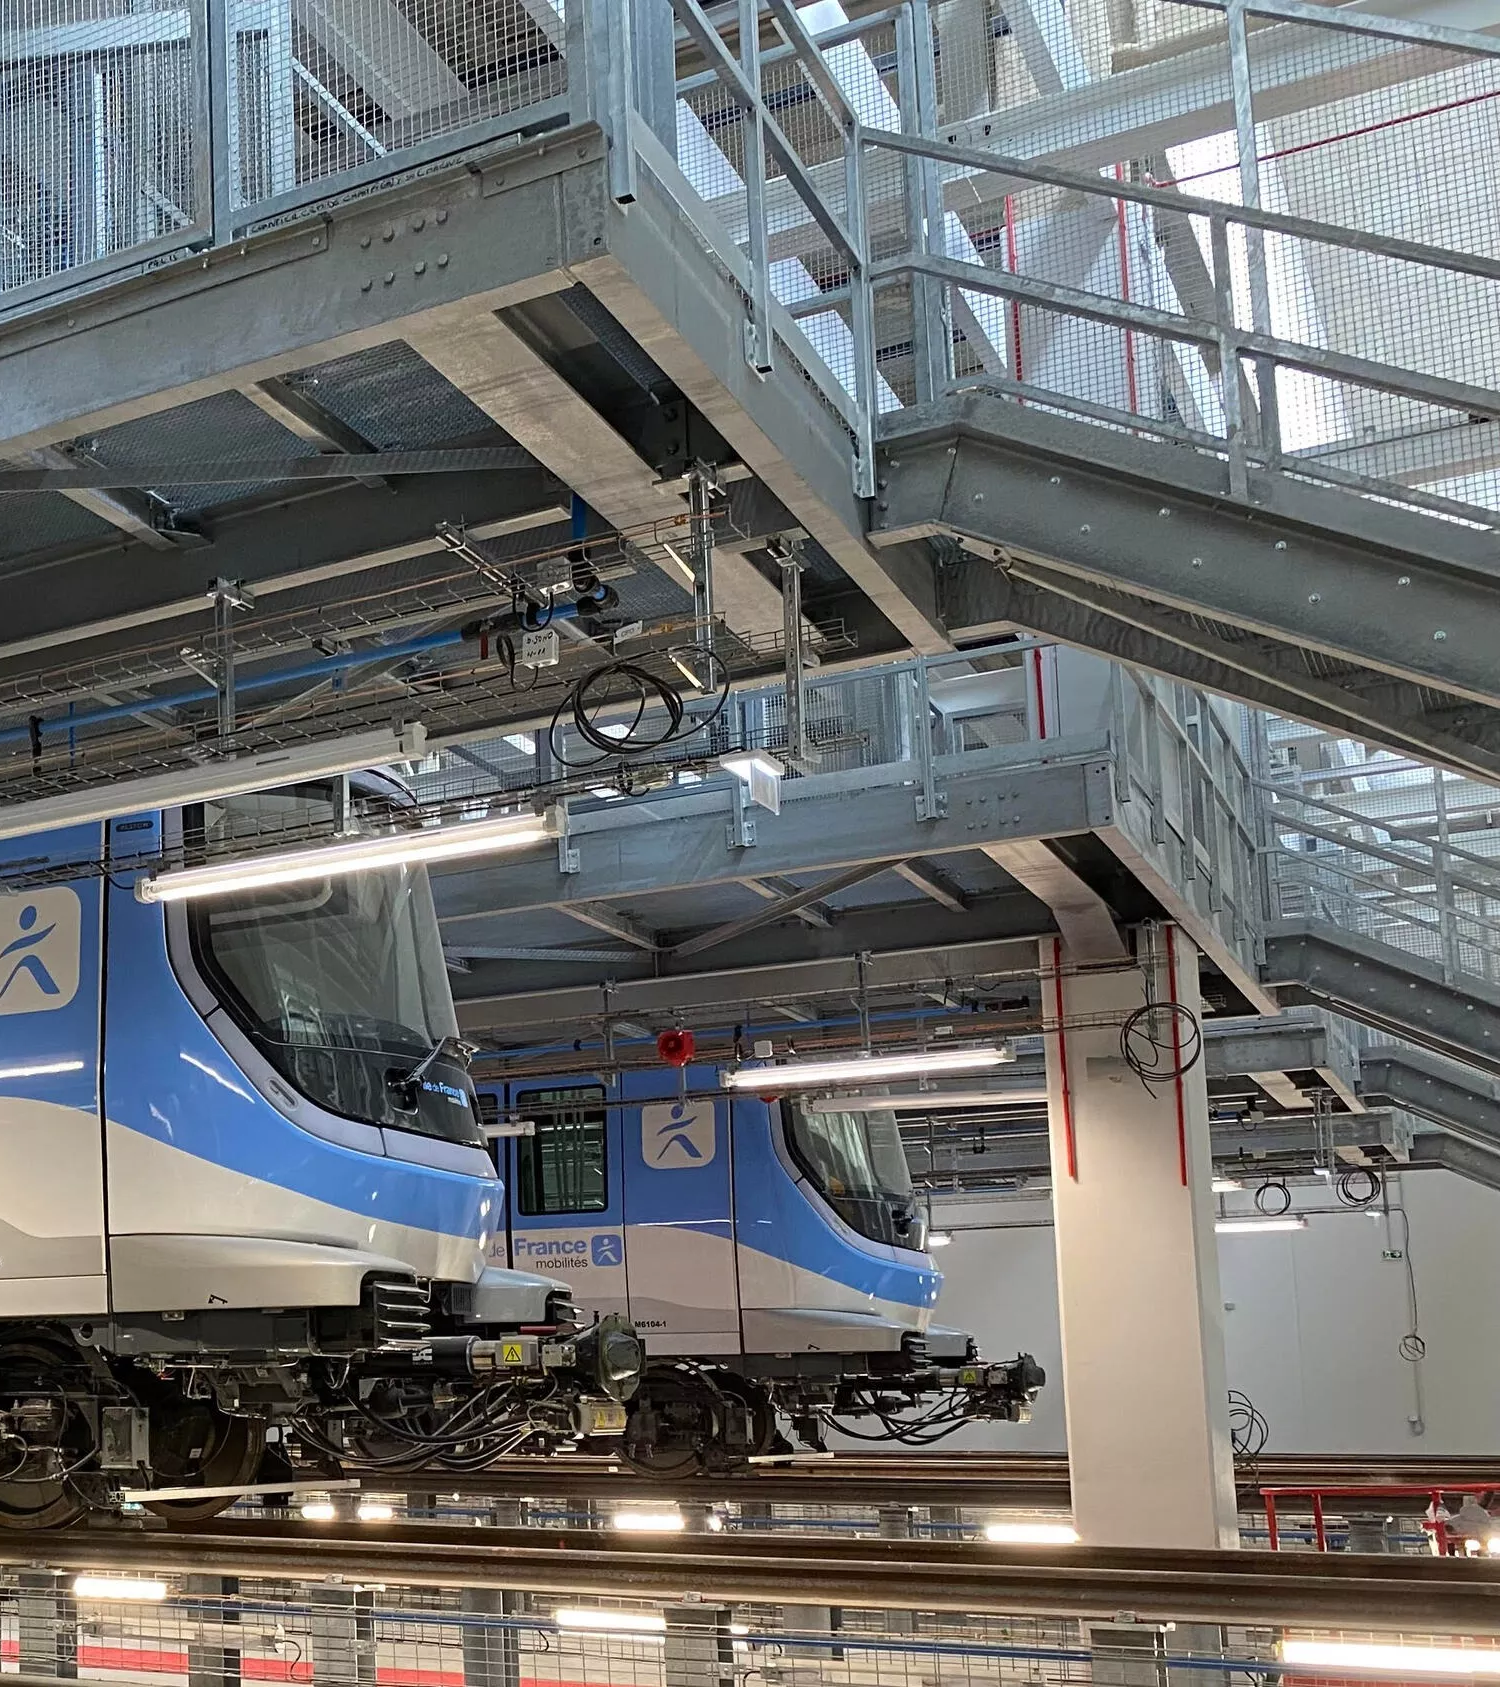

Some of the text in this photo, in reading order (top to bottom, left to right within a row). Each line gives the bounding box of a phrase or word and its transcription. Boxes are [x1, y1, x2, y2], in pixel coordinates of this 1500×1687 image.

[514, 1238, 587, 1257] France
[536, 1256, 588, 1269] mobilités
[634, 1320, 666, 1328] M6104-1
